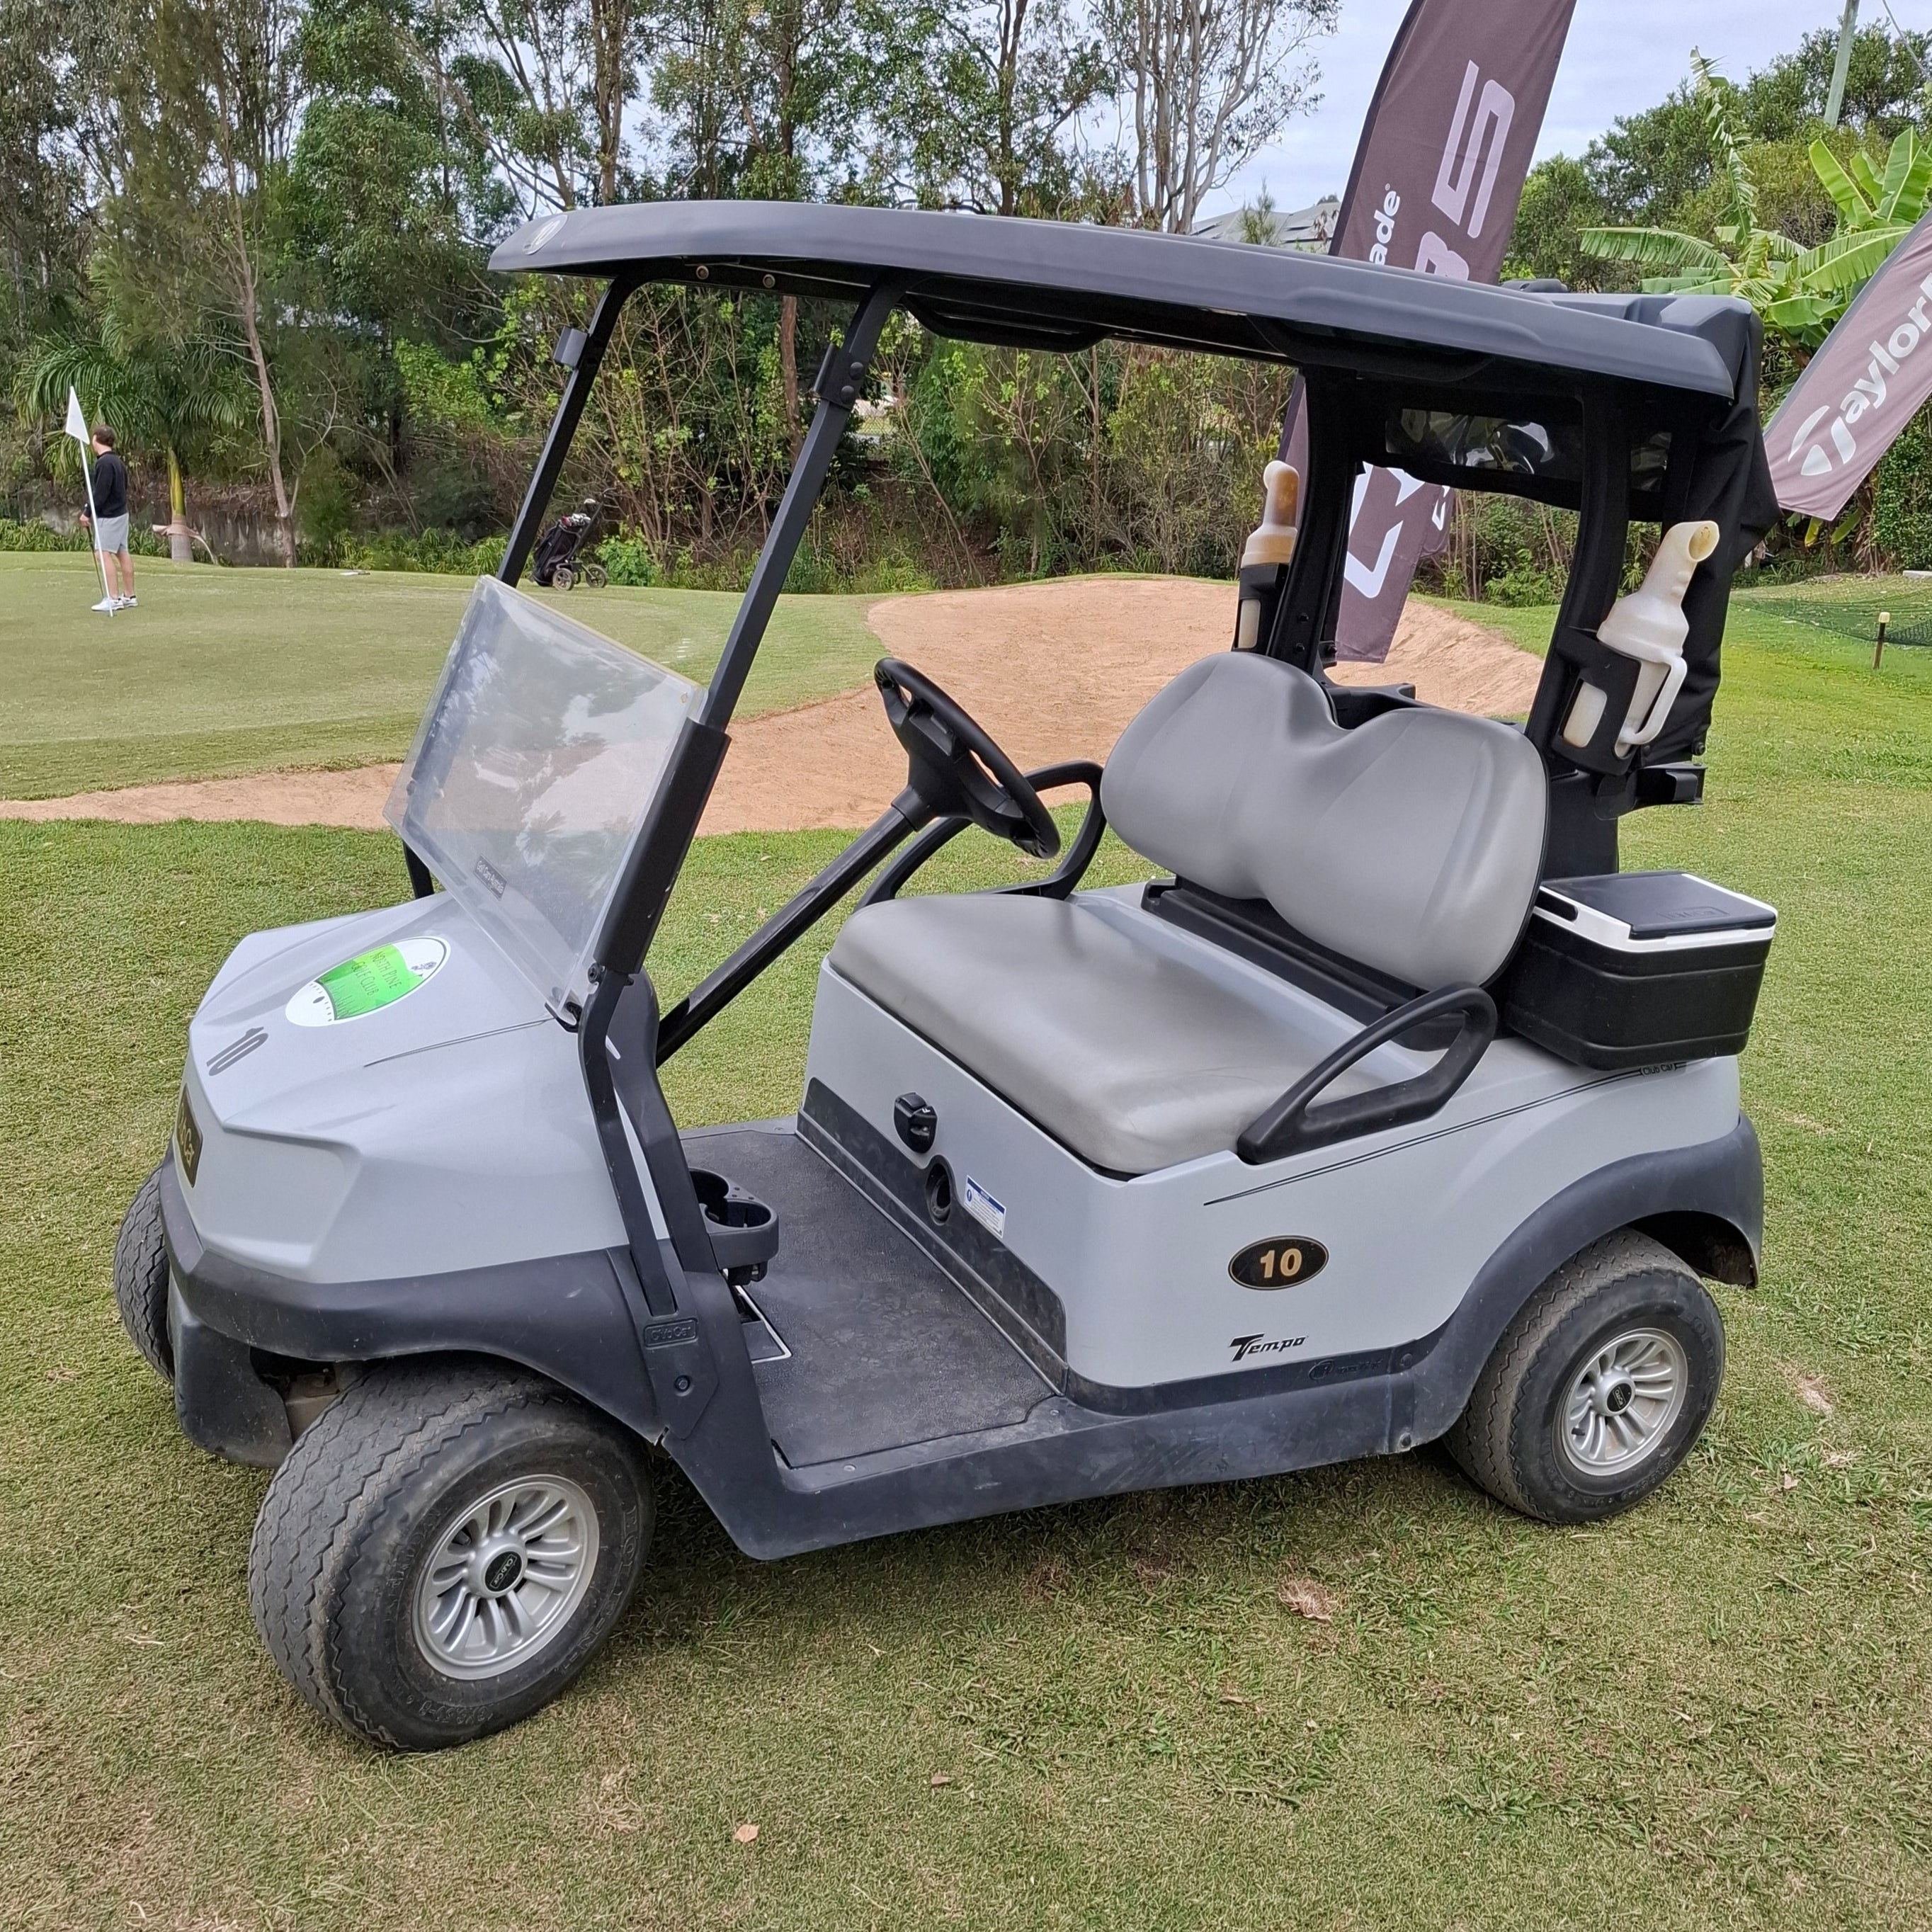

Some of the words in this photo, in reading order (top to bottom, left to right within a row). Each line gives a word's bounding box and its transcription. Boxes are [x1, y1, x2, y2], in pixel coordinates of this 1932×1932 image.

[1788, 273, 1932, 477] Taylor
[351, 961, 372, 979] GOLF
[382, 969, 402, 989] PINE
[360, 976, 380, 996] CLUB
[1260, 1248, 1303, 1278] 10
[1229, 1332, 1308, 1363] Tempo
